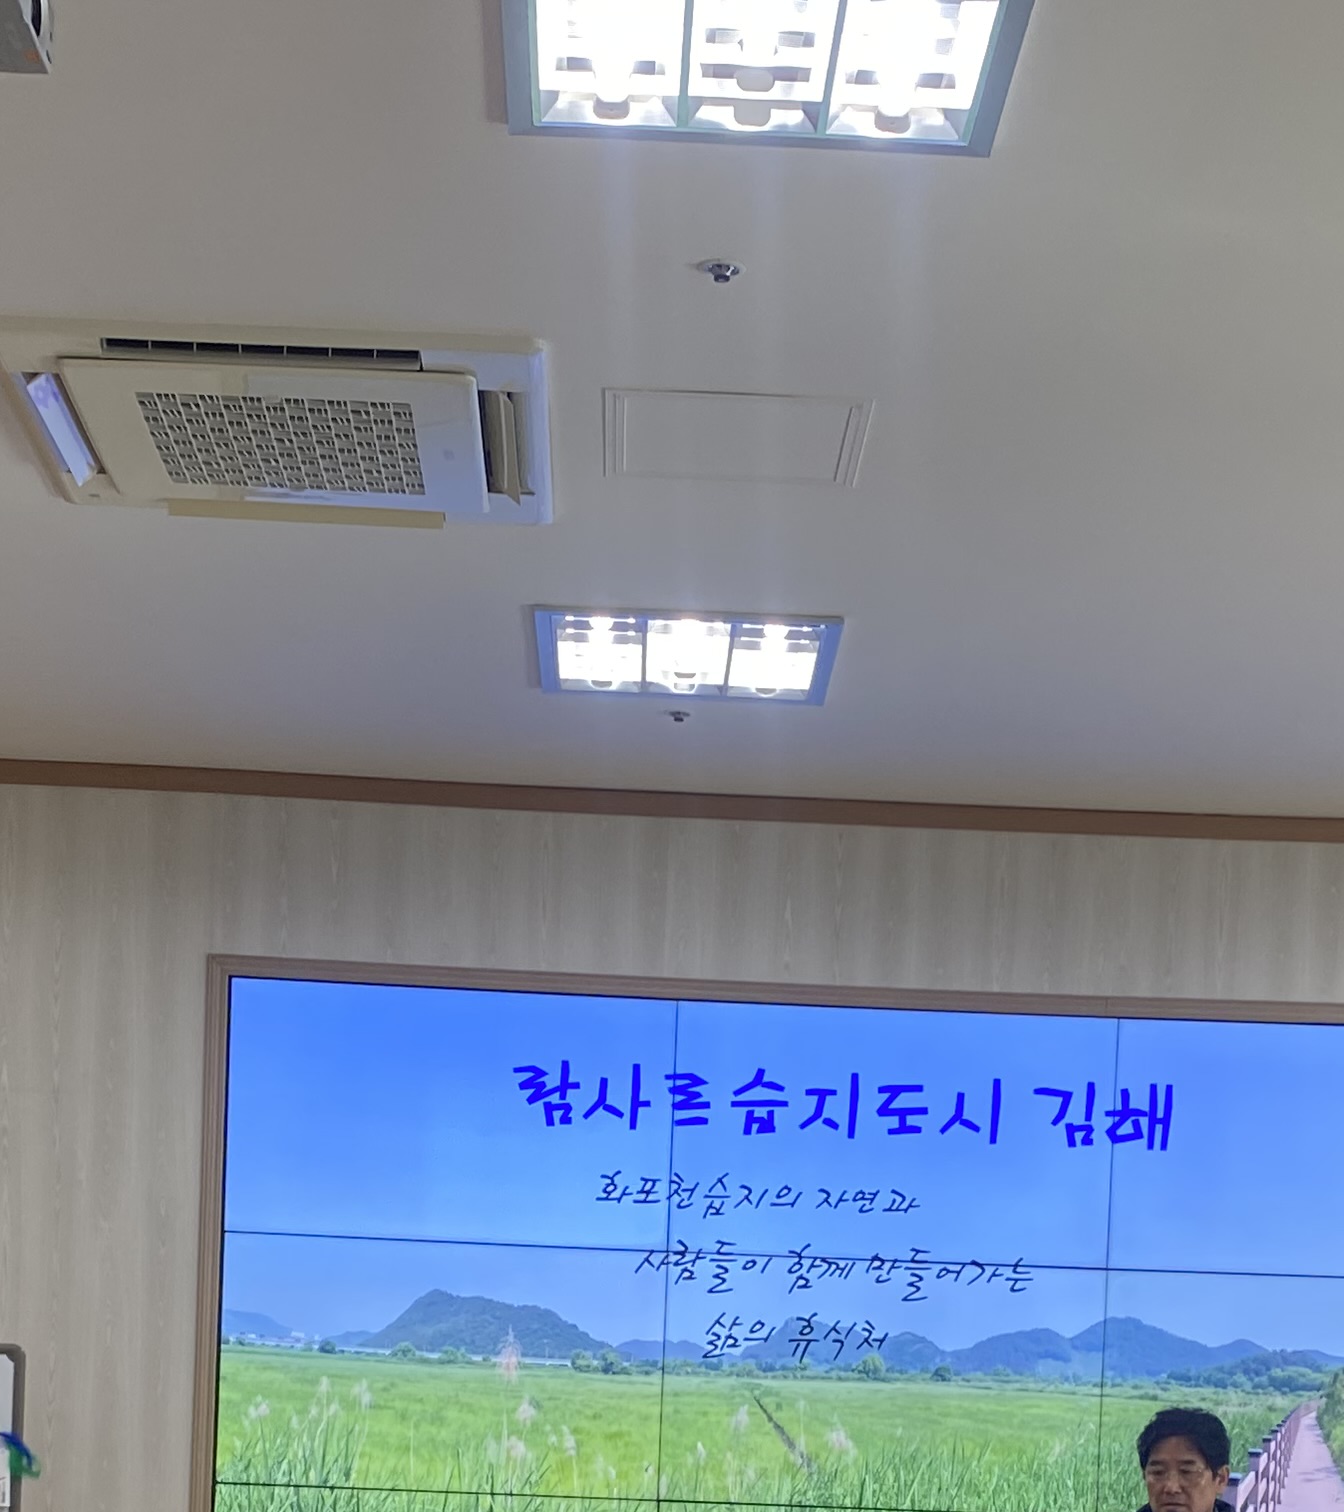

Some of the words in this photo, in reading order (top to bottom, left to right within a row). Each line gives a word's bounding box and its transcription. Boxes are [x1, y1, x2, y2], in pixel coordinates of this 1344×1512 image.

[513, 1060, 1002, 1144] 람사르습지도시
[1034, 1081, 1175, 1151] 김해
[596, 1171, 802, 1219] 화포천습지의
[817, 1185, 922, 1216] 자연과
[635, 1239, 773, 1294] 사람들이
[788, 1243, 854, 1294] 함께
[867, 1248, 1034, 1301] 만들어가는
[702, 1312, 777, 1359] 삶의
[788, 1313, 890, 1363] 휴식처
